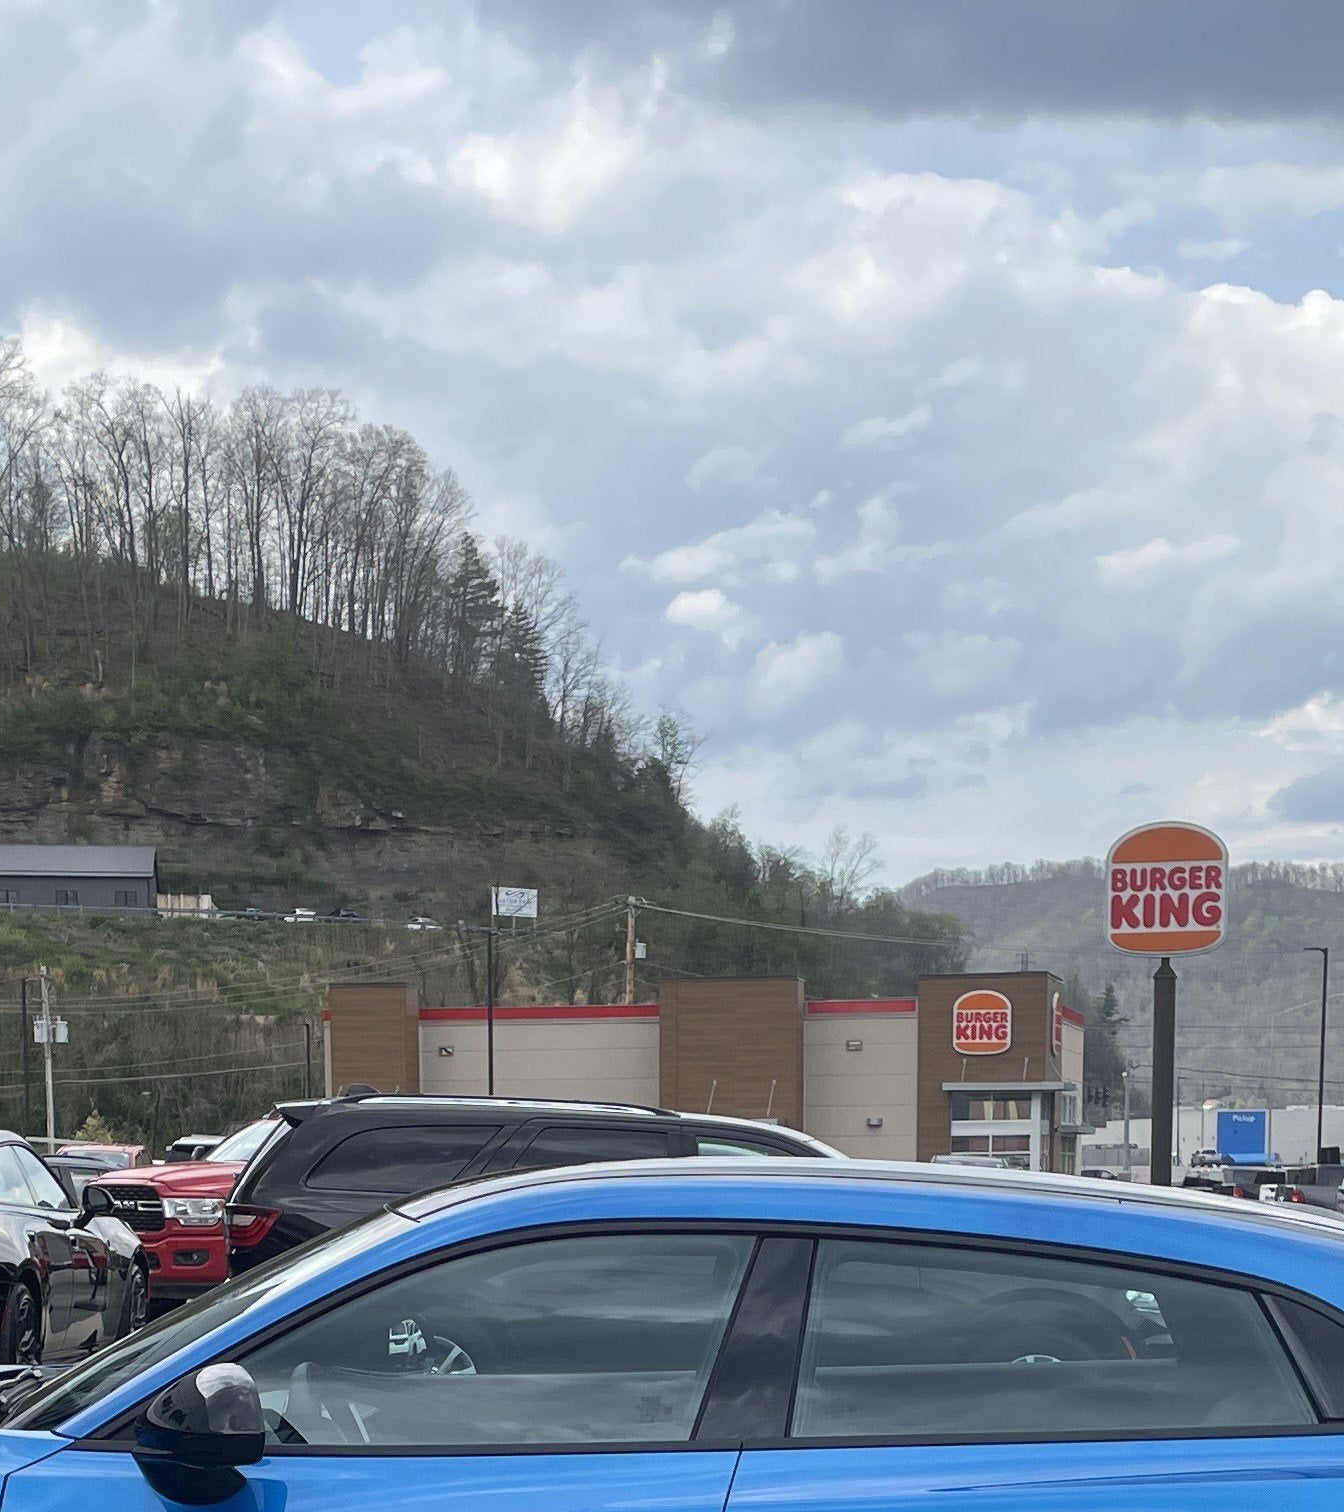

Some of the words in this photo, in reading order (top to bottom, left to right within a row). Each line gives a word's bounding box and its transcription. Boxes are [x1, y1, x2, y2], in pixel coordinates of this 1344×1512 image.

[1111, 866, 1223, 892] BURGER
[1110, 891, 1222, 929] KING
[956, 1011, 1009, 1023] BURGER
[956, 1023, 1008, 1041] KING
